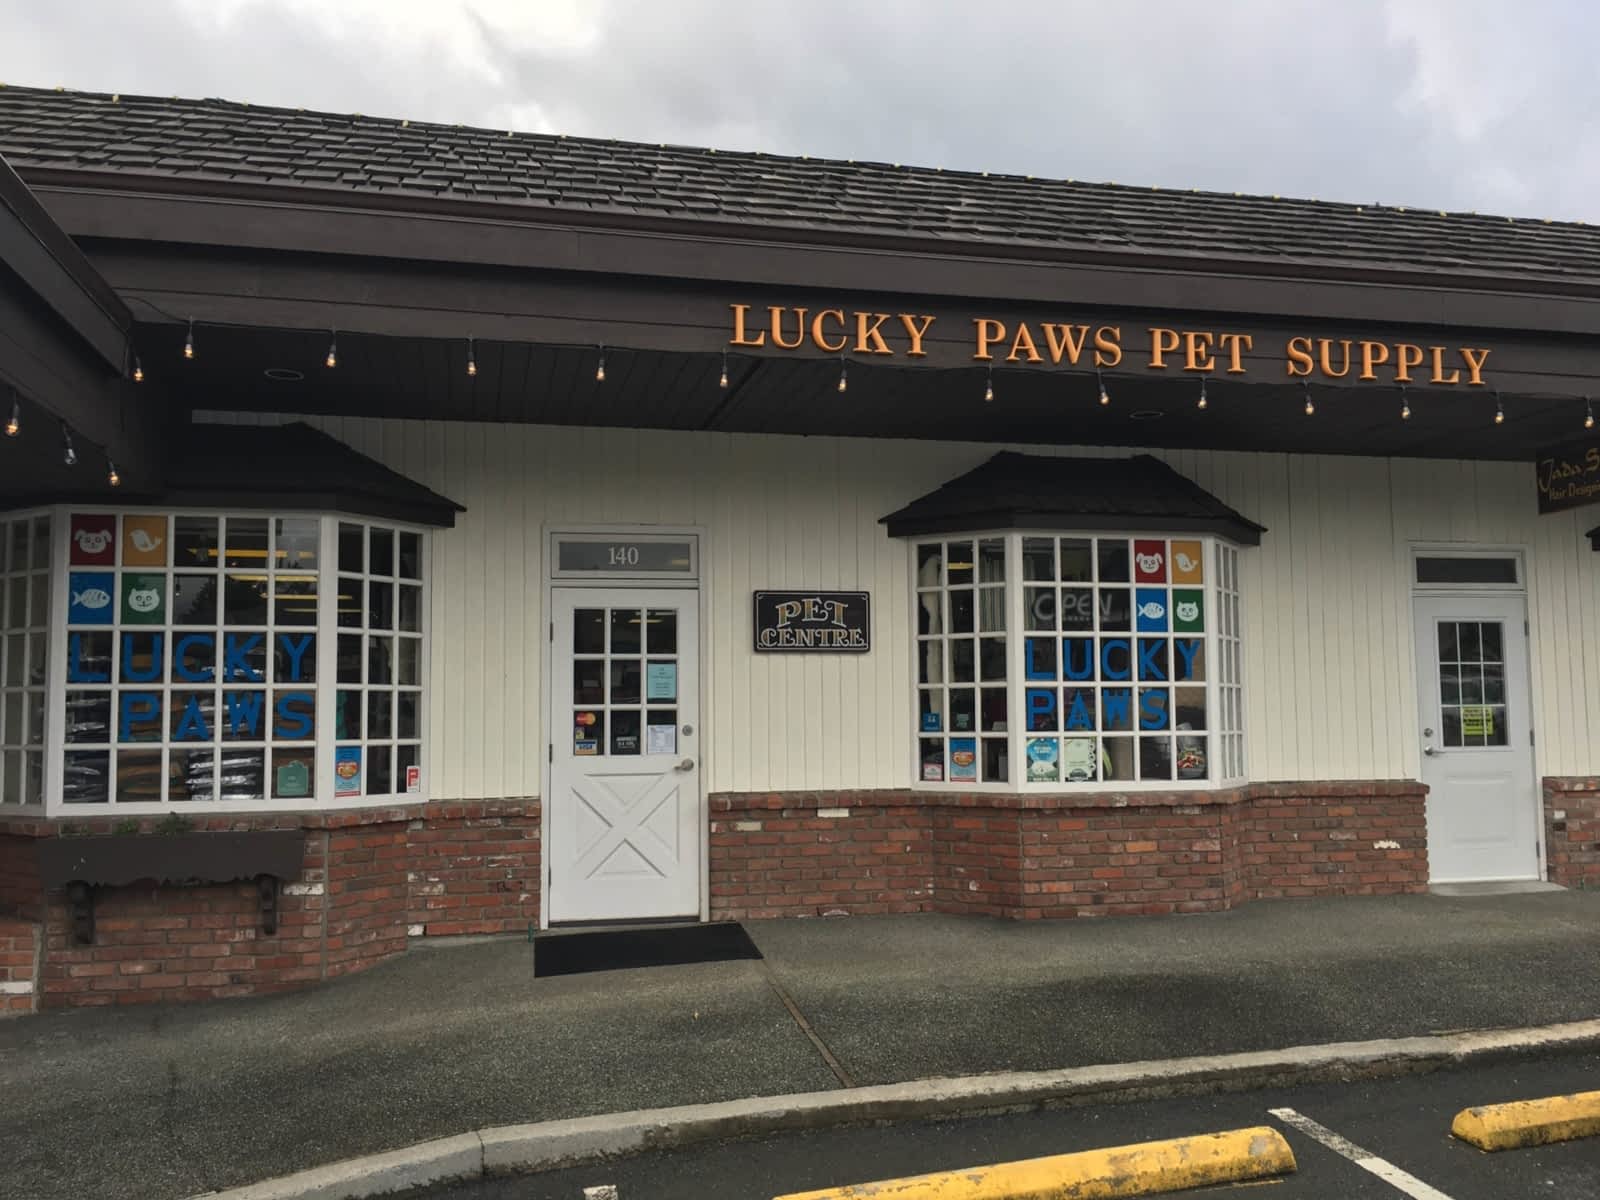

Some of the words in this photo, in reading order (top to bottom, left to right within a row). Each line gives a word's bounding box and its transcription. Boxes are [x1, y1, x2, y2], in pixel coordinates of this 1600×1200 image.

[729, 303, 936, 357] LUCKY
[972, 318, 1123, 368] PAWS
[1148, 327, 1253, 374] PET
[1286, 336, 1492, 386] SUPPLY
[608, 546, 639, 565] 140
[775, 597, 849, 628] PET
[68, 633, 312, 682] LUCKY
[761, 627, 866, 647] CENTRE
[1026, 638, 1200, 681] LUCKY
[119, 691, 315, 742] PAWS
[1026, 688, 1168, 731] PAWS
